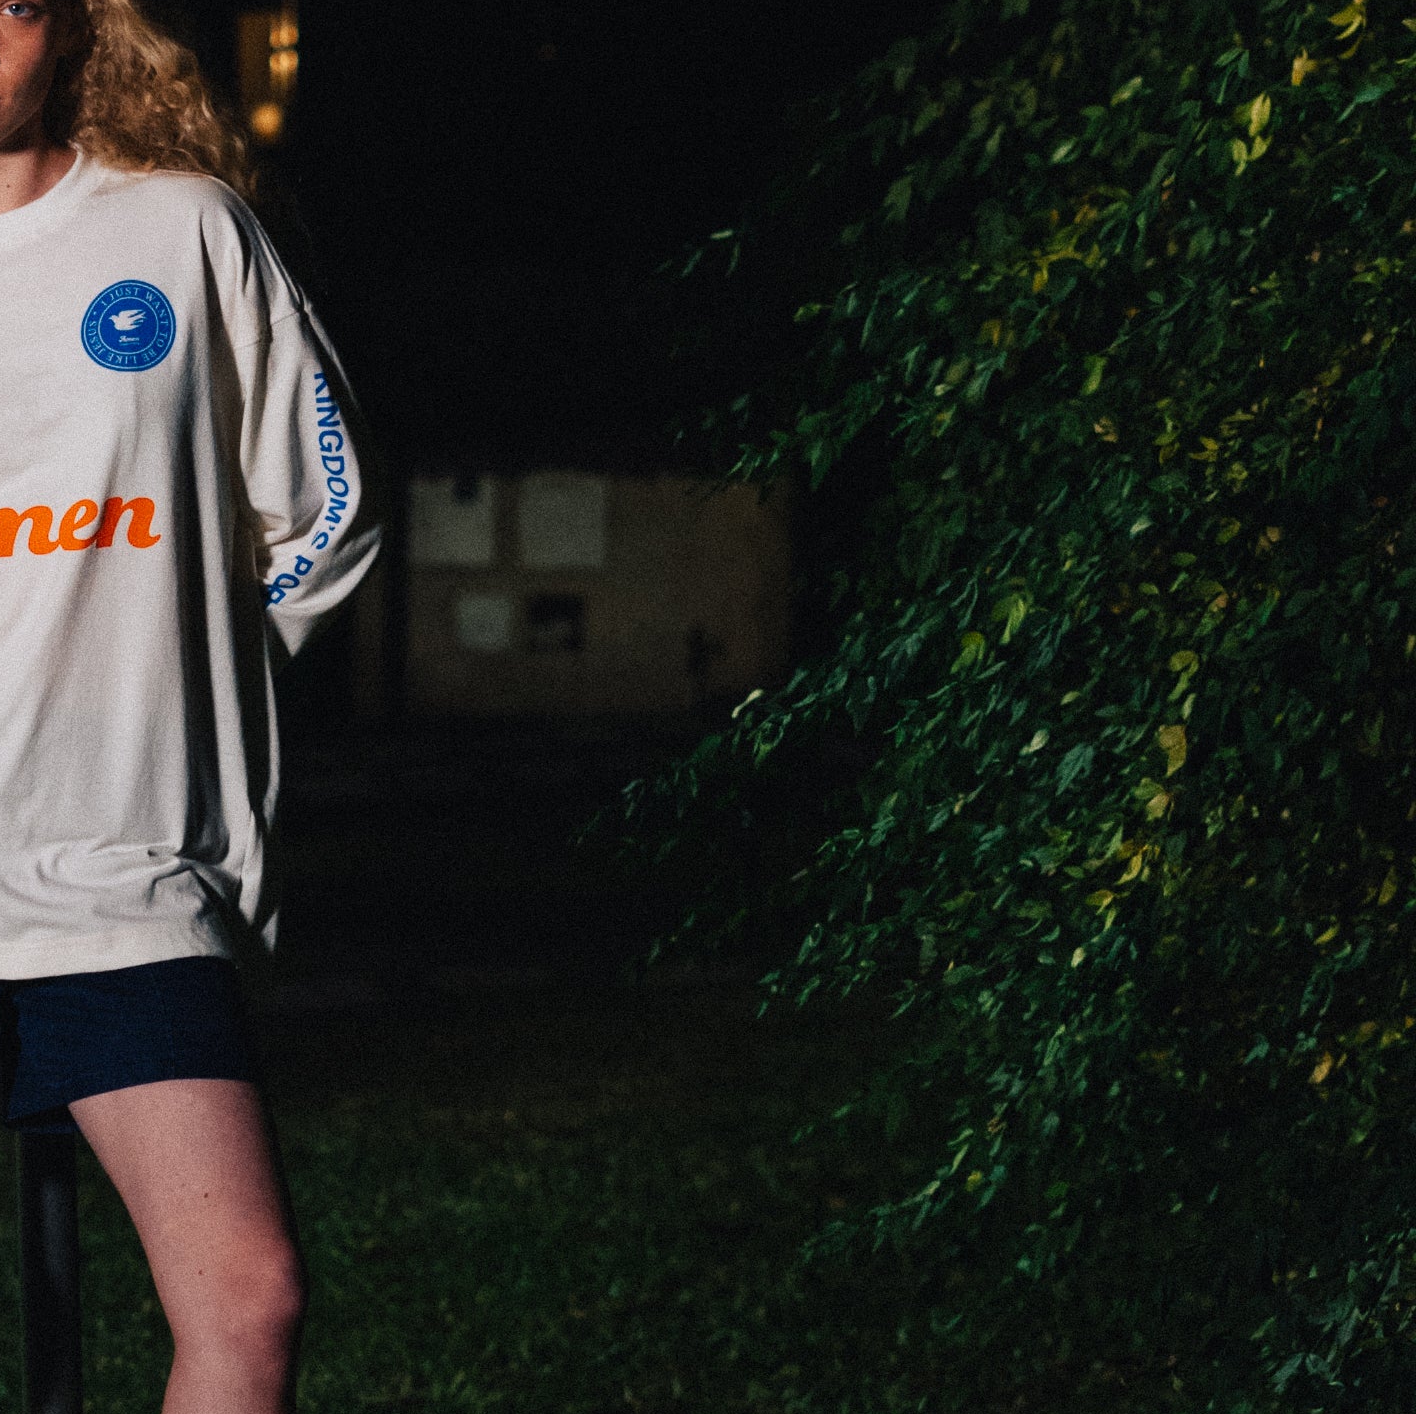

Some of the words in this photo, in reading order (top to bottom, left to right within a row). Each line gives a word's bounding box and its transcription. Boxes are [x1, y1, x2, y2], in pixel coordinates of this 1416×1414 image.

[109, 286, 140, 301] JUST
[145, 291, 169, 327] WANT
[87, 320, 106, 355] JESUS
[155, 331, 168, 348] TO
[105, 353, 137, 364] LIKE
